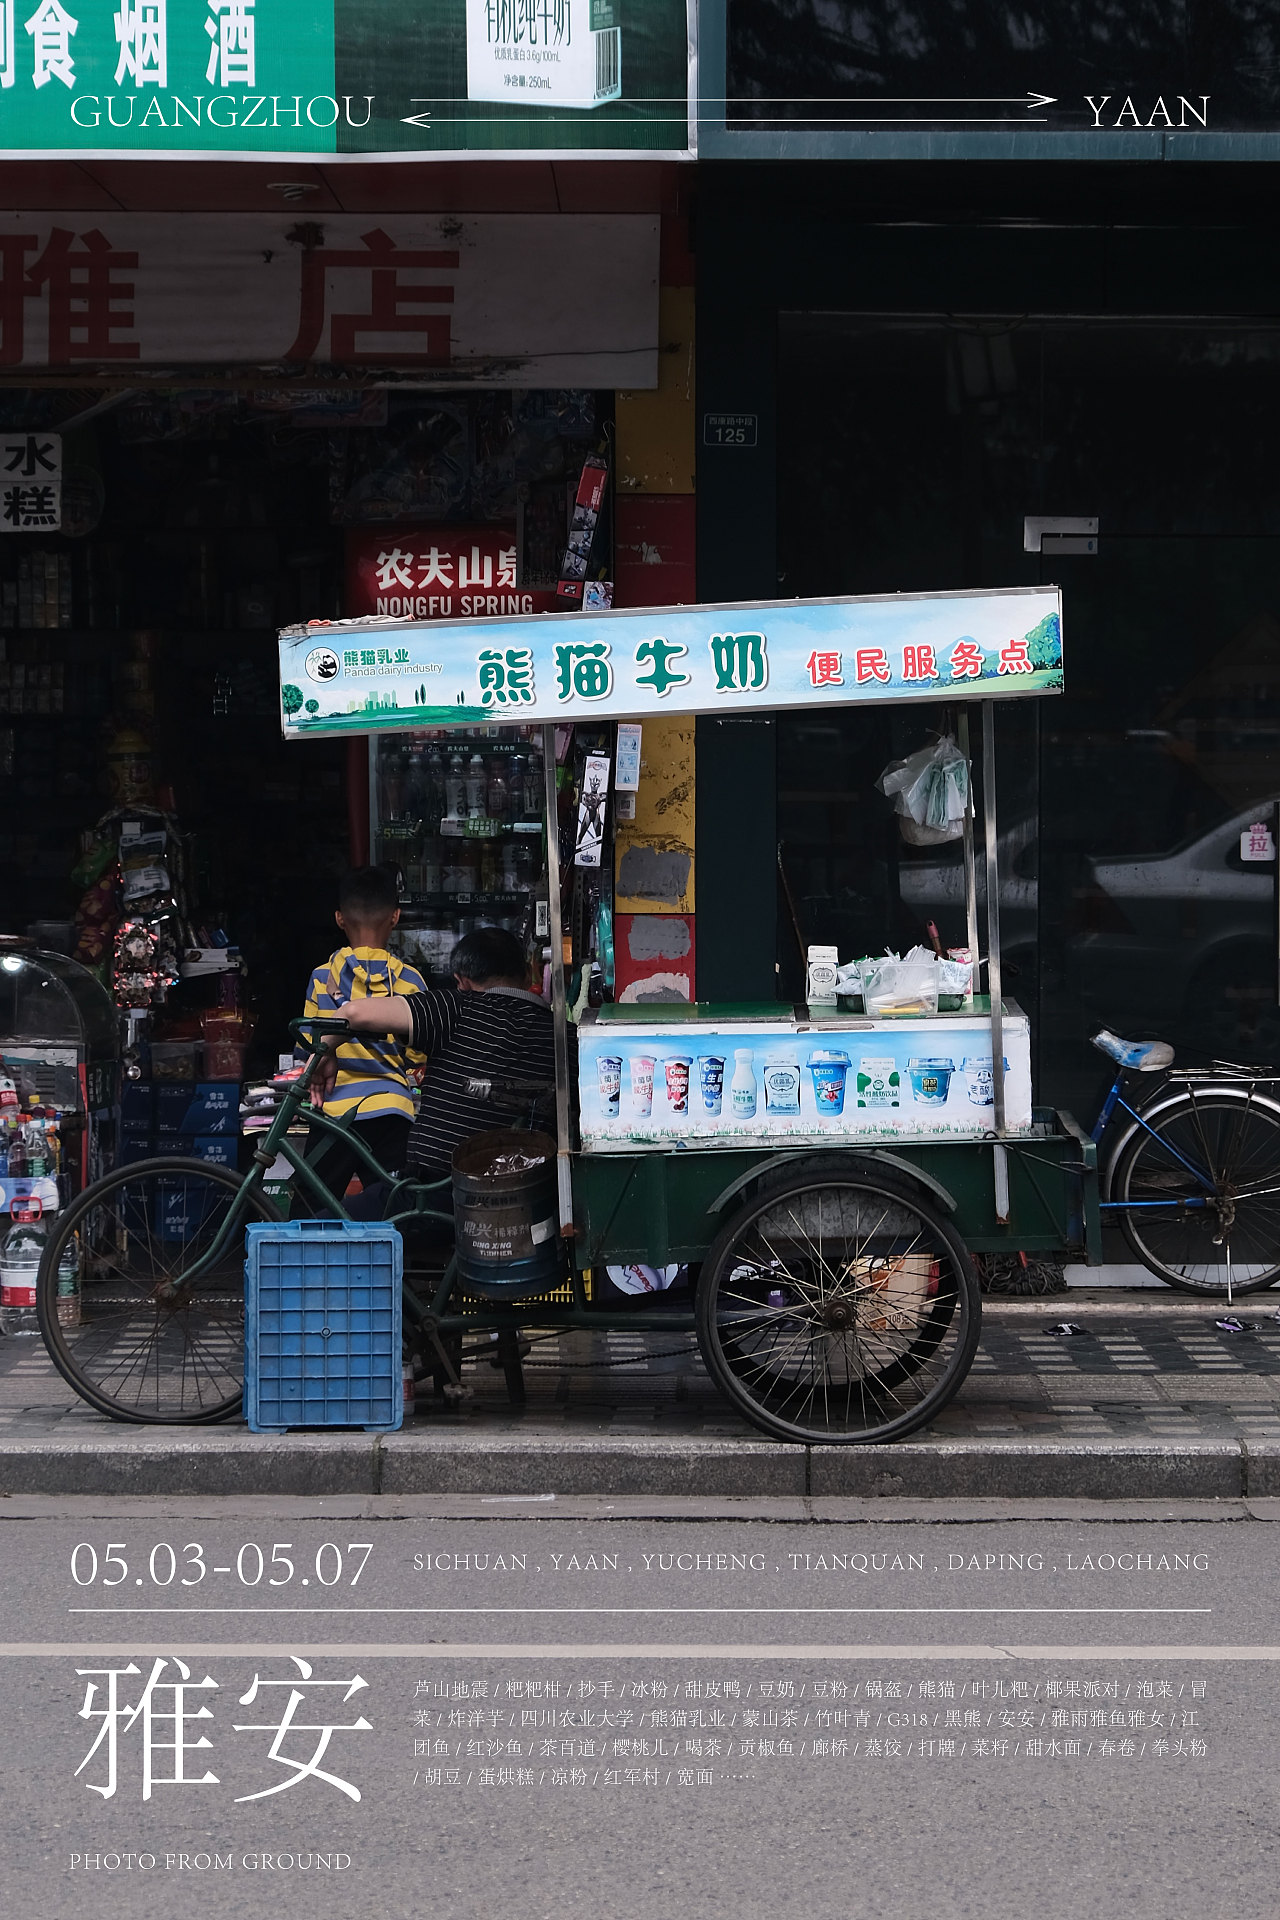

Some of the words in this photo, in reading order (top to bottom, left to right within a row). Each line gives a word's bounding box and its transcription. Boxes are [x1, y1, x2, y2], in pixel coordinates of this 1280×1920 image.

[0, 0, 256, 90] 食烟酒
[715, 428, 746, 443] 125
[376, 596, 452, 617] NONGFU
[460, 594, 534, 615] SPRING
[343, 648, 410, 667] 熊猫乳业
[806, 639, 1034, 685] 便民服务点
[344, 667, 376, 677] Panda
[378, 665, 402, 676] dairy
[404, 663, 443, 674] industry
[477, 633, 768, 706] 熊猫牛奶
[1249, 836, 1269, 852] 拉
